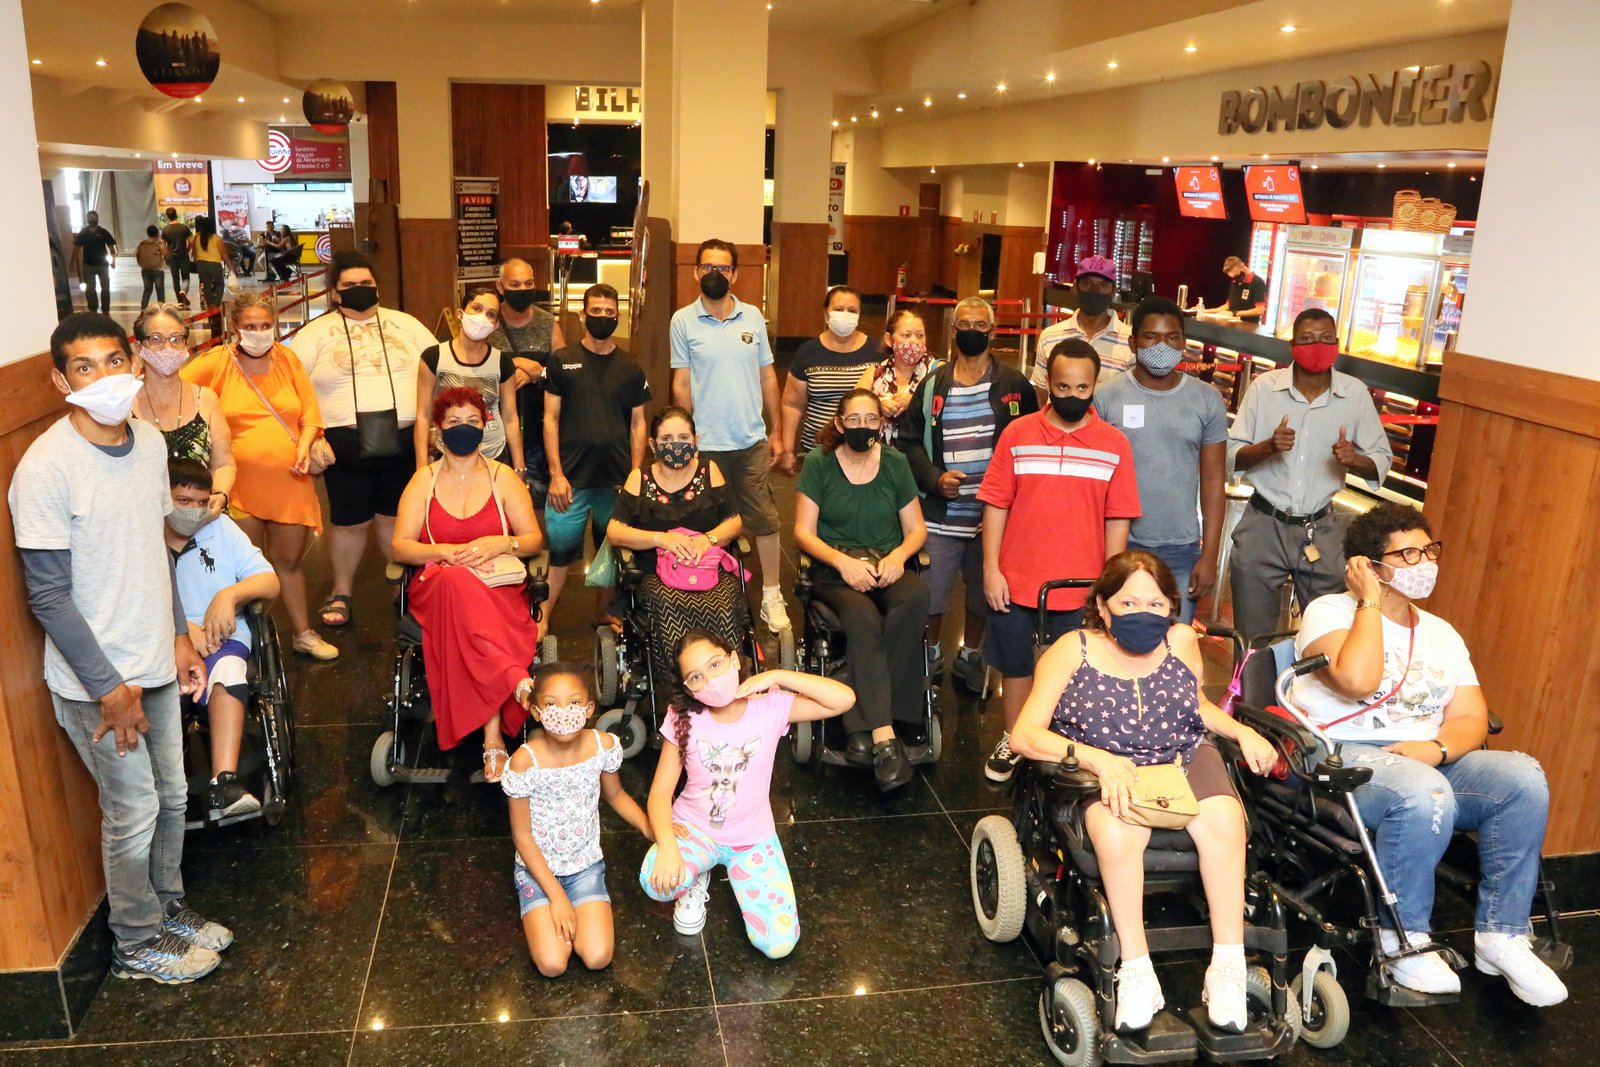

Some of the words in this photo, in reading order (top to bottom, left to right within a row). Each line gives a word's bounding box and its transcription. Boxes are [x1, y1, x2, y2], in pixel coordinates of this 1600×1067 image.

[575, 86, 642, 113] BILH
[1217, 60, 1498, 136] BOMBONIER
[157, 160, 175, 169] Em
[175, 160, 203, 169] breve
